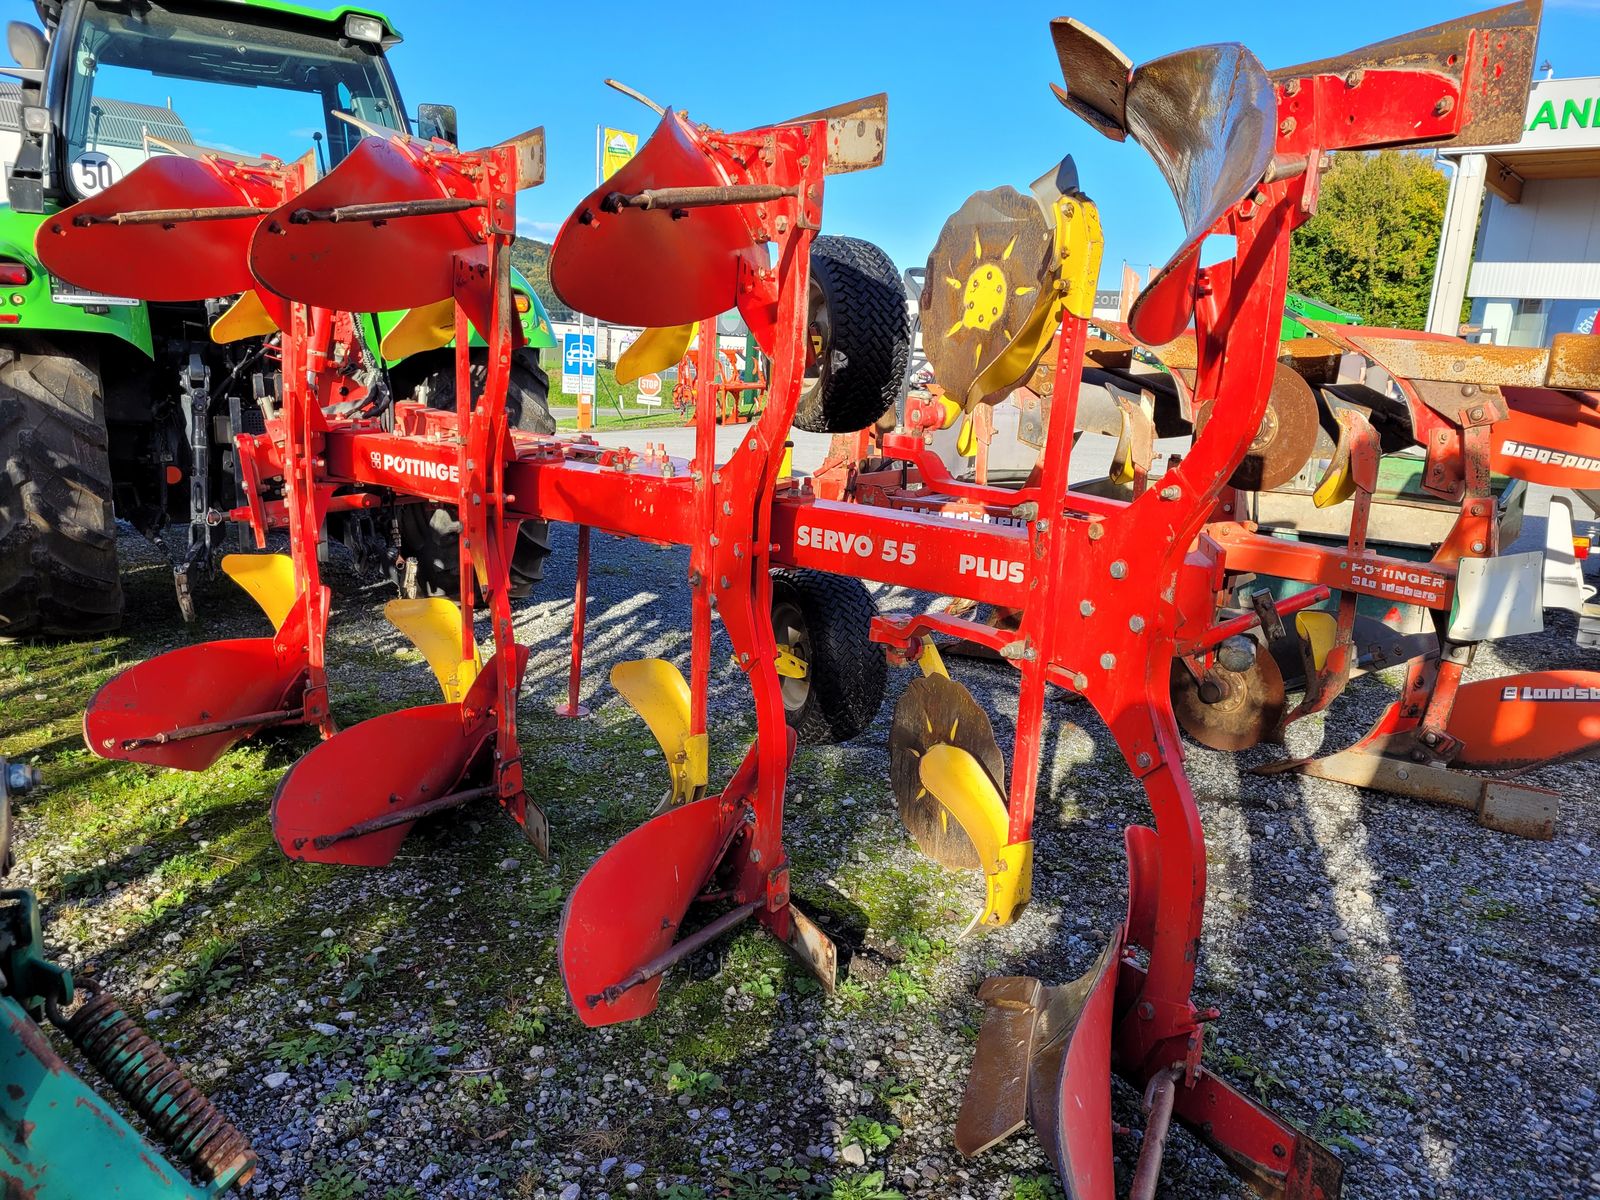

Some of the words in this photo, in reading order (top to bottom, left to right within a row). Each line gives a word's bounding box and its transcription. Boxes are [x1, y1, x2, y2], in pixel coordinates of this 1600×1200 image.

[1523, 96, 1600, 131] AN
[81, 159, 113, 190] 50
[641, 379, 659, 391] STOP
[797, 525, 873, 557] SERVO
[881, 540, 917, 565] 55
[959, 554, 1024, 583] PLUS
